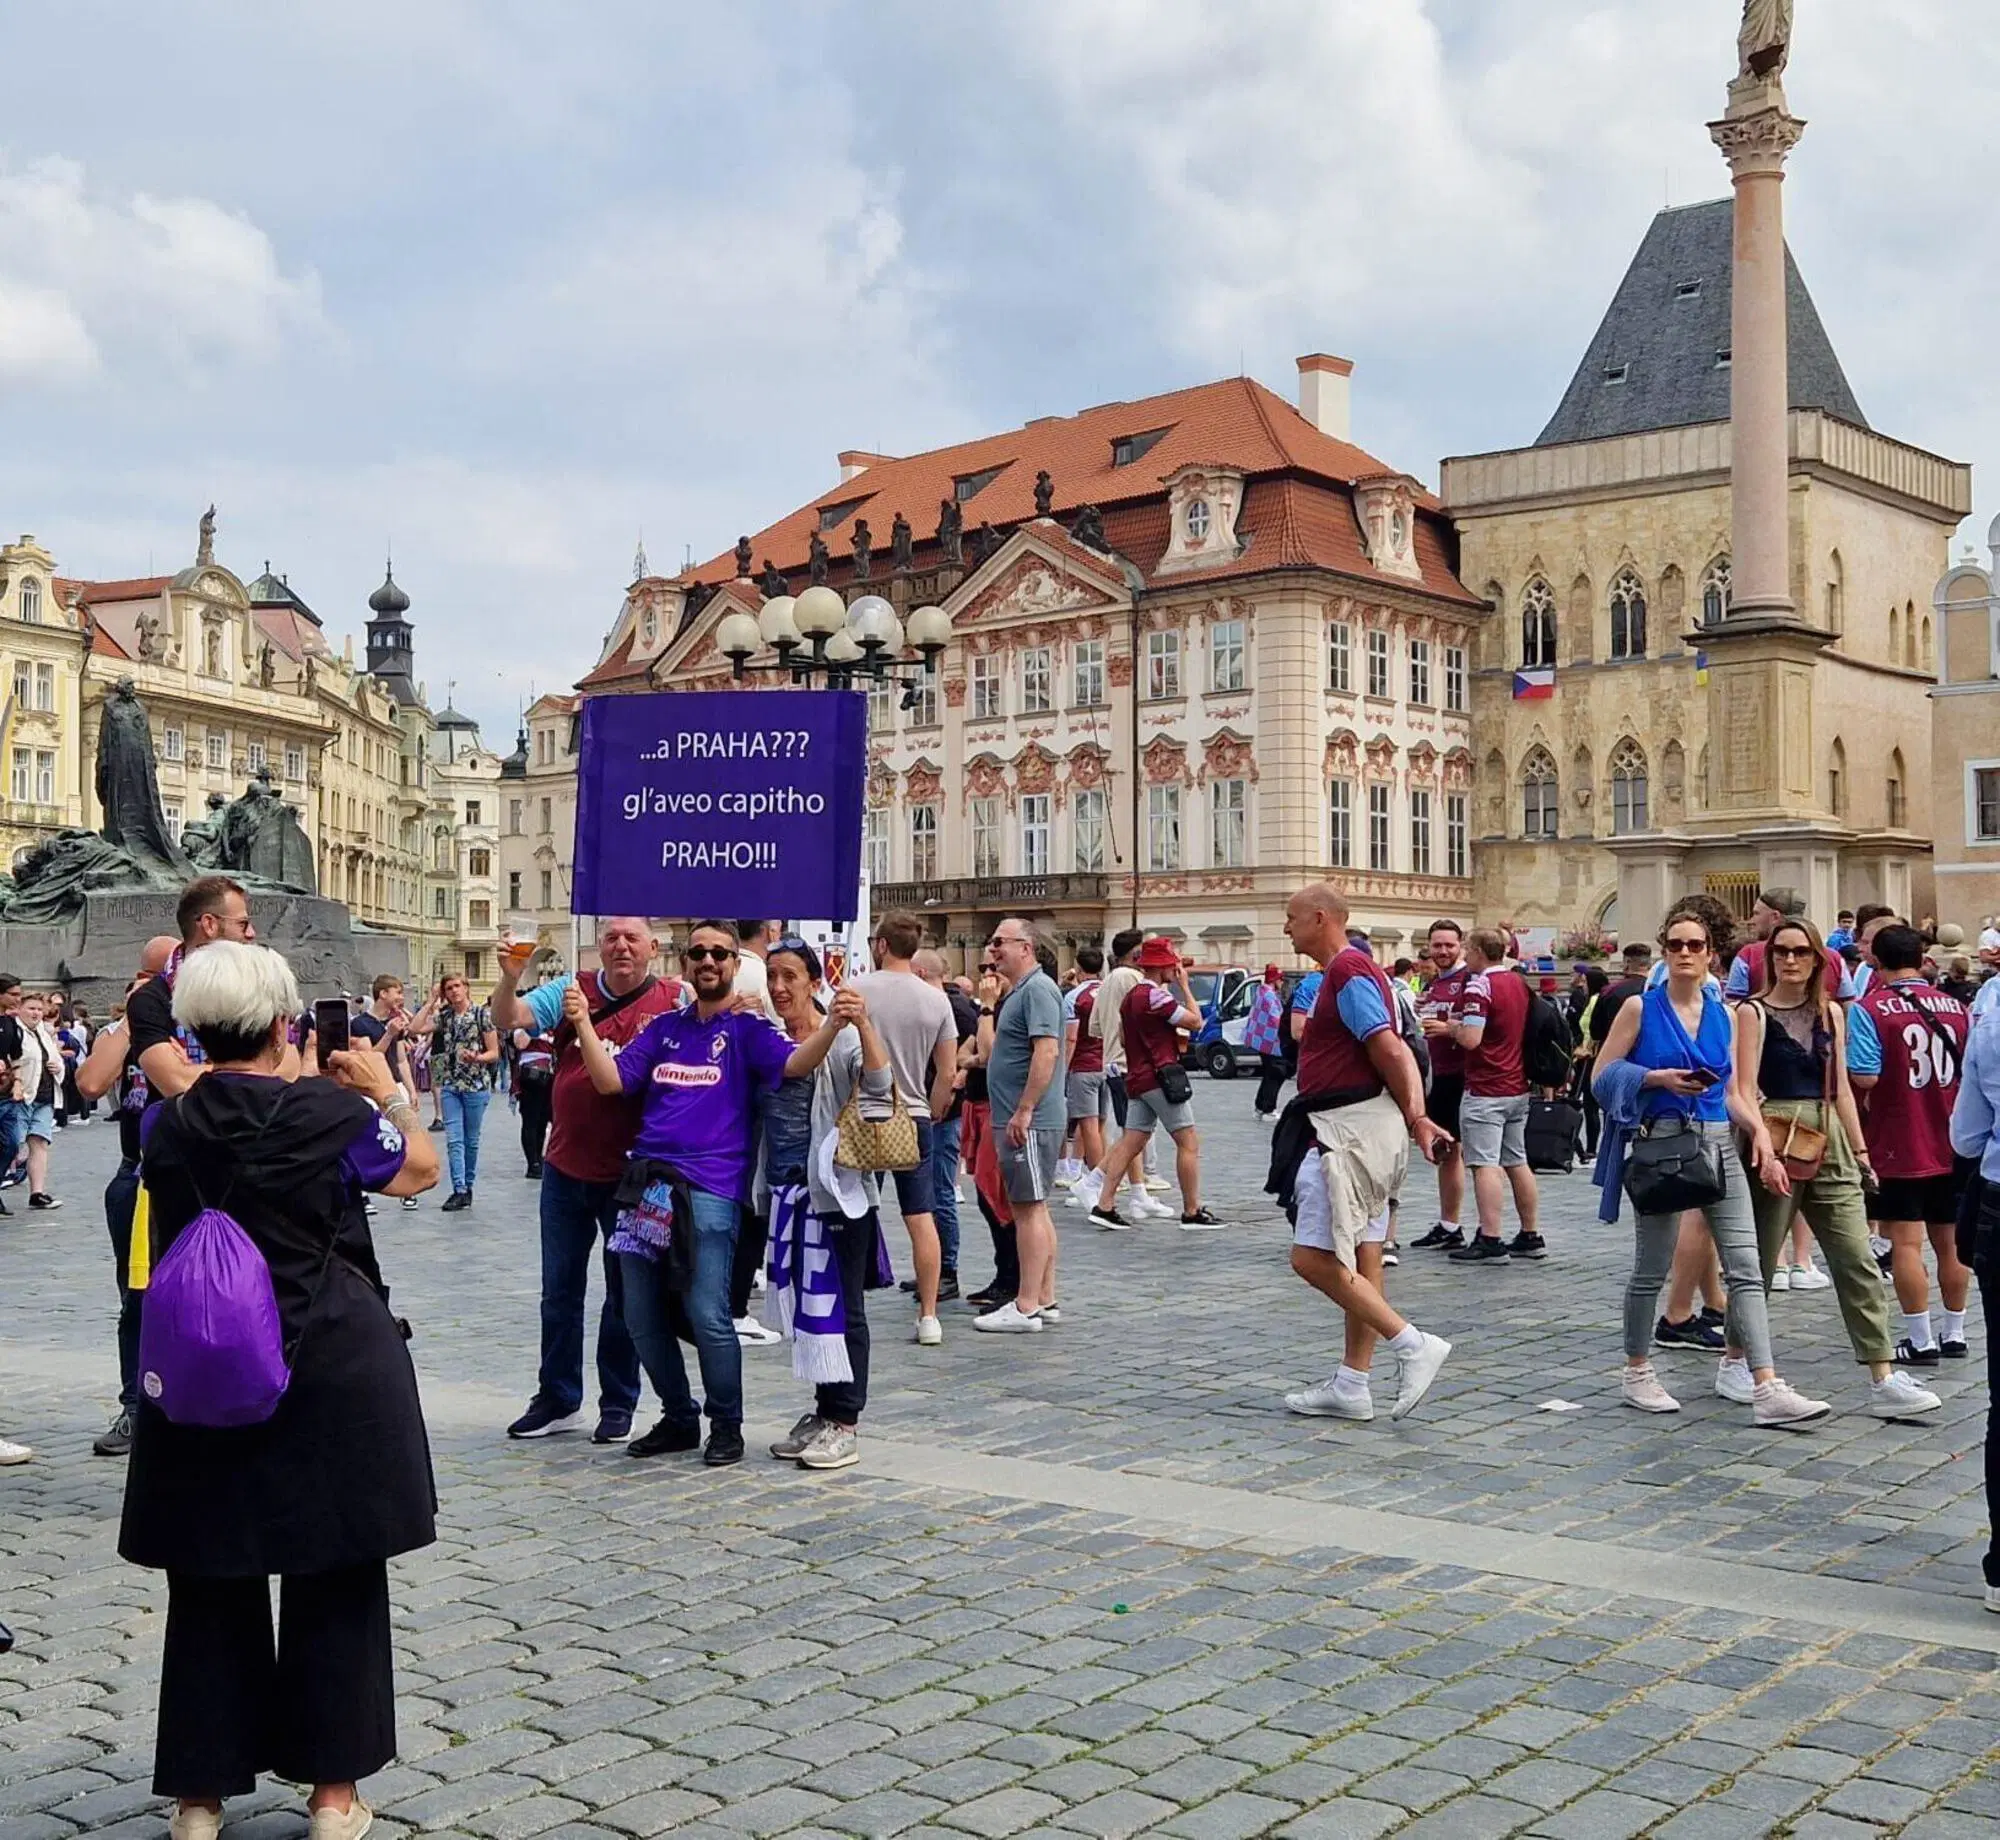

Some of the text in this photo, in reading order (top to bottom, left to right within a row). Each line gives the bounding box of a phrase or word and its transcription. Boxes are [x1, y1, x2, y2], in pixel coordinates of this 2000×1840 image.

[639, 731, 810, 760] ...a PRAHA???
[623, 786, 825, 820] gl'aveo capitho
[661, 842, 777, 869] PRAHO!!!
[1902, 1023, 1957, 1089] 30
[656, 1066, 718, 1082] Nintendo
